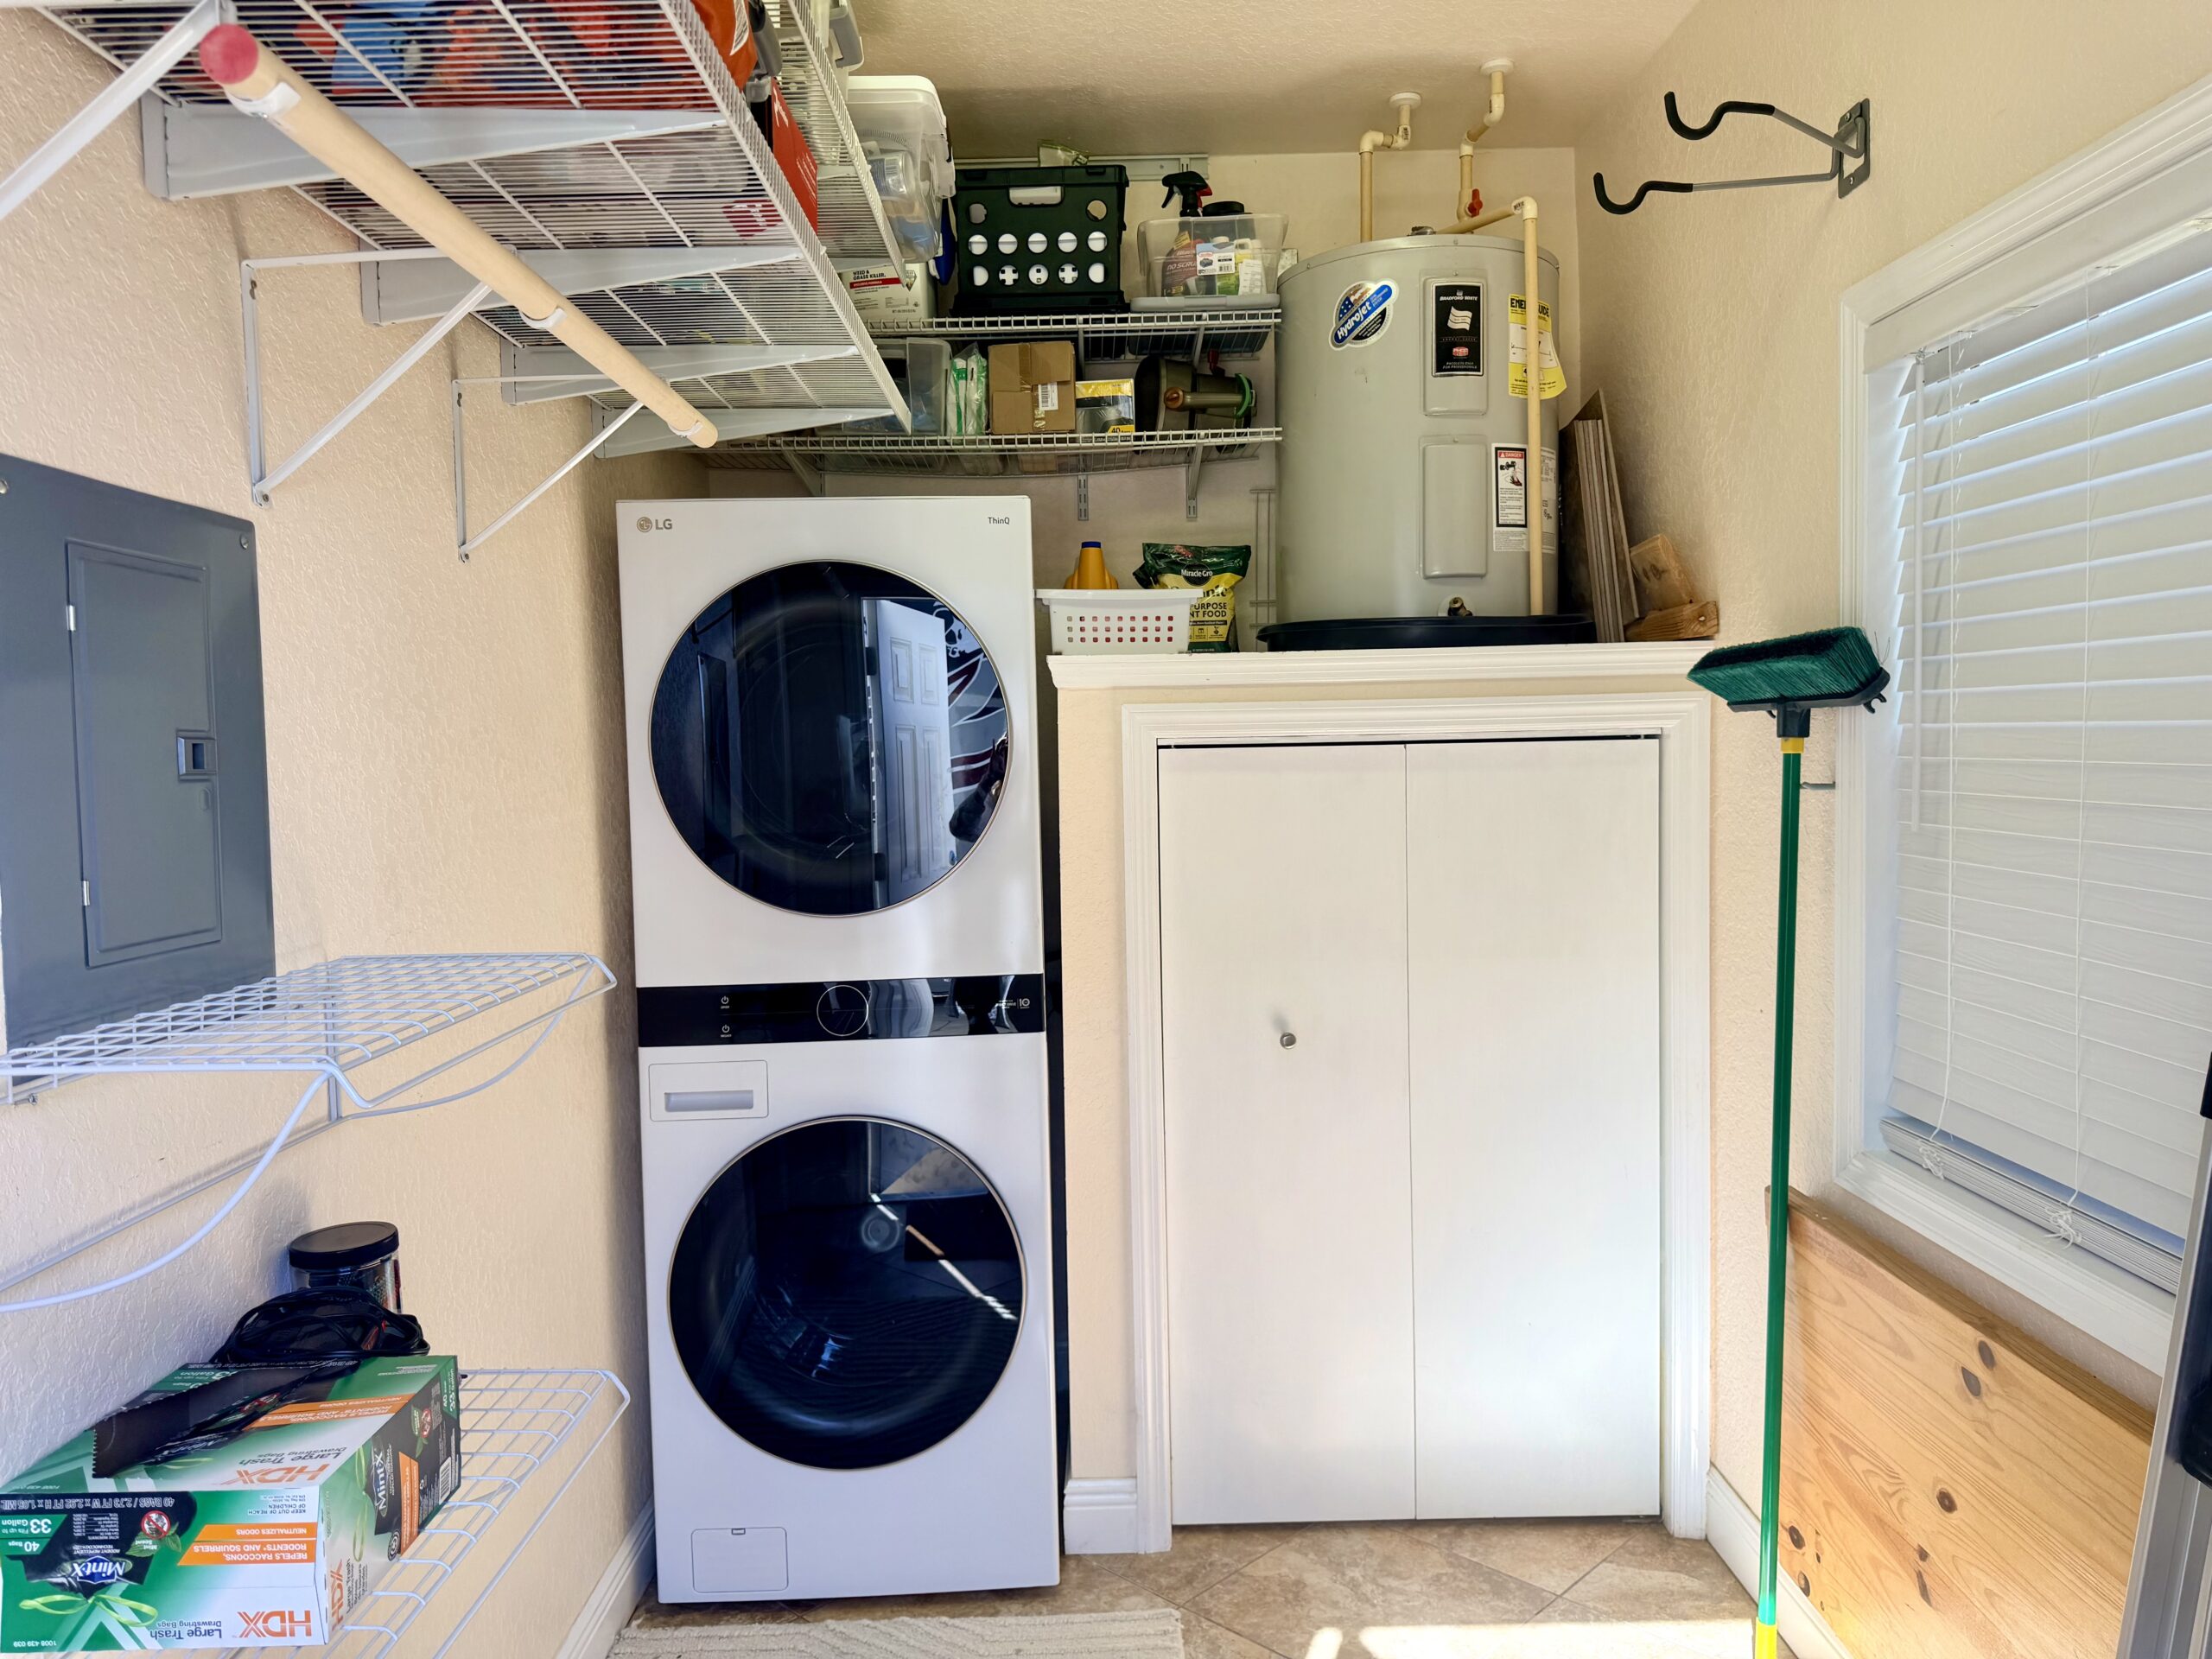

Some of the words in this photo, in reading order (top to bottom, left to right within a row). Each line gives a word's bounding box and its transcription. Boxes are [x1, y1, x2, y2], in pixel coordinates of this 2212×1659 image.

[1179, 259, 1197, 268] SCRU
[1337, 301, 1372, 340] Hydrojet
[655, 518, 673, 530] LG
[988, 517, 1010, 525] ThinQ
[1202, 609, 1227, 619] FOOD
[449, 1392, 455, 1411] 33
[287, 1446, 348, 1457] Drawstring
[290, 1452, 342, 1462] Large
[238, 1456, 285, 1465] Trash
[222, 1464, 332, 1484] HDX
[44, 1499, 52, 1510] H
[53, 1499, 64, 1510] FT
[91, 1498, 101, 1509] W
[101, 1498, 112, 1509] FT
[138, 1497, 162, 1508] BAGS
[163, 1497, 175, 1507] 40
[30, 1518, 52, 1534] 33
[23, 1541, 40, 1552] 40
[193, 1544, 241, 1553] SQUIRRELS
[223, 1553, 273, 1561] RACCOONS,
[275, 1552, 308, 1560] REPELS
[330, 1559, 344, 1632] HDX
[237, 1610, 312, 1638] HDX
[149, 1629, 184, 1640] Trash
[187, 1627, 223, 1640] Large
